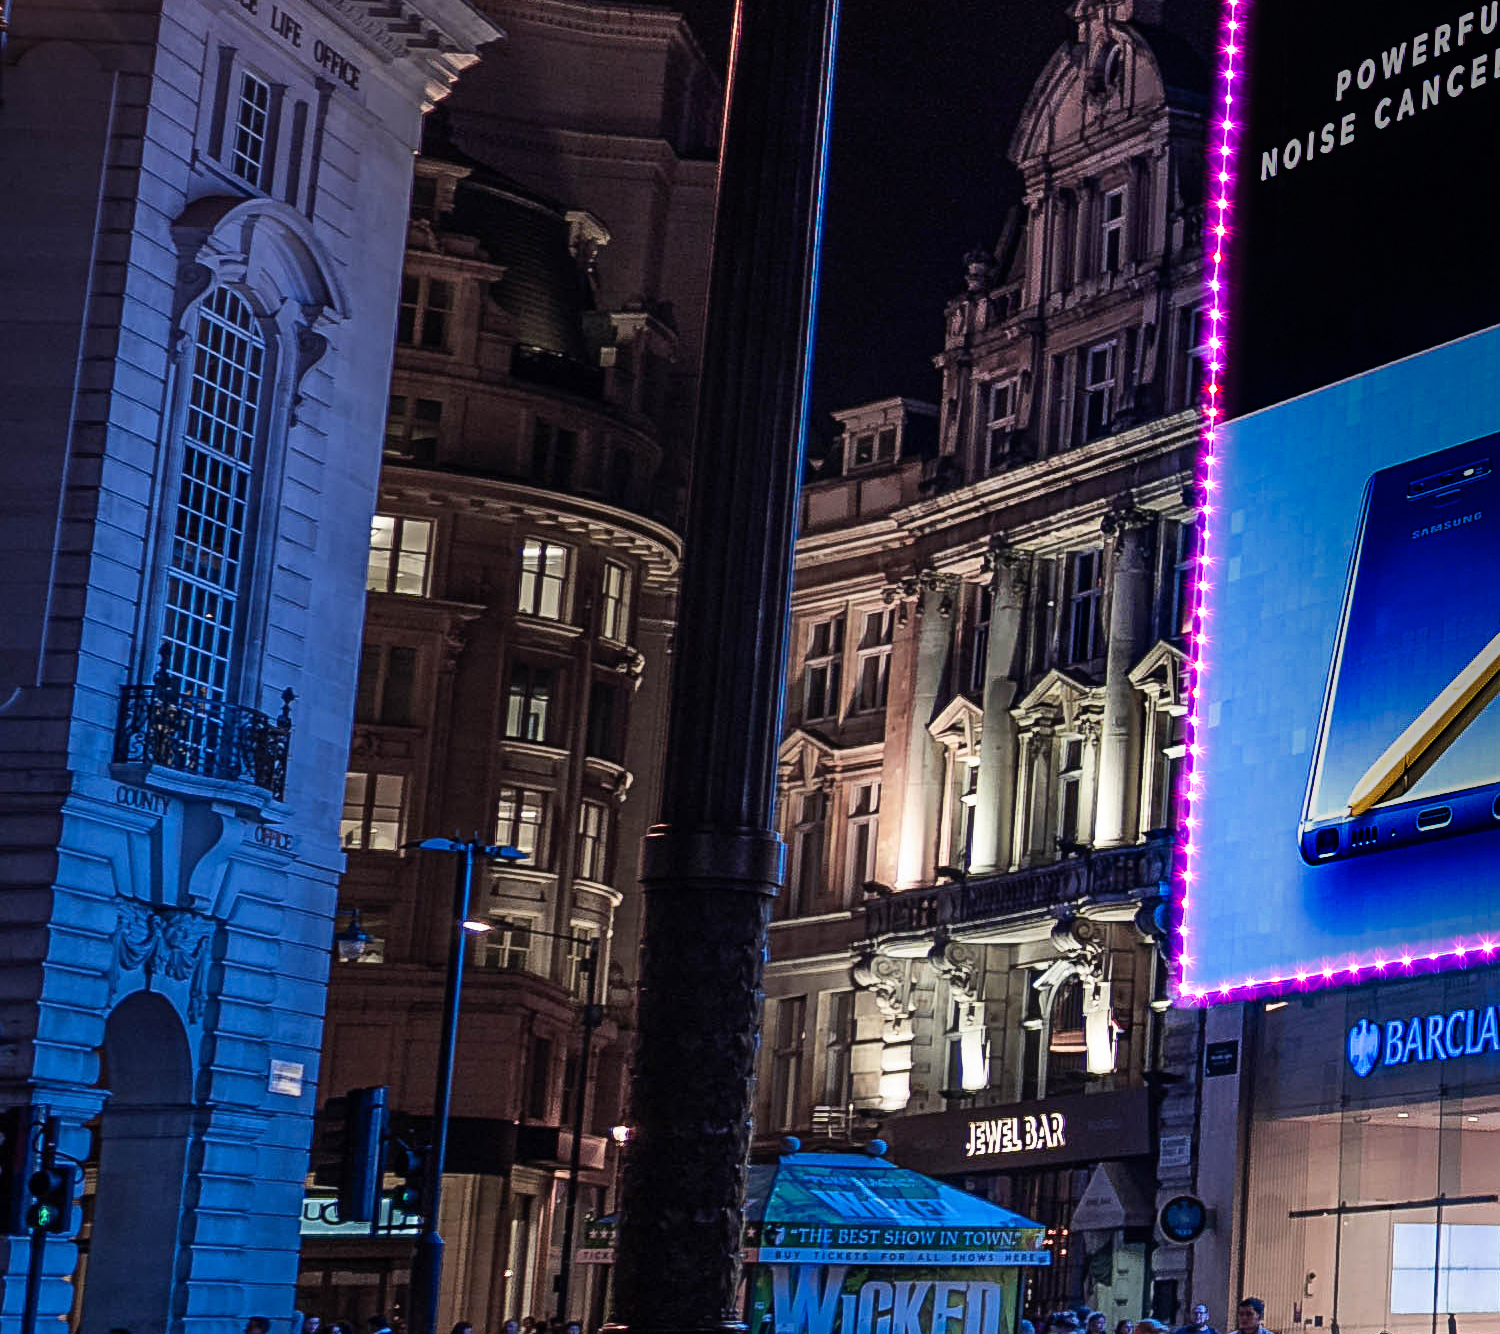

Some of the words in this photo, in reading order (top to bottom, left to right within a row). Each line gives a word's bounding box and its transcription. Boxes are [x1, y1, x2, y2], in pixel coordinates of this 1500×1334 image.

[270, 4, 303, 48] LIFE
[313, 39, 361, 91] OFFICE
[1260, 112, 1356, 181] NOISE
[1411, 510, 1483, 540] SAMSUNG
[965, 1119, 1022, 1157] JEWEL
[1024, 1113, 1066, 1151] BAR
[838, 1228, 880, 1246] BEST
[884, 1229, 935, 1246] SHOW
[940, 1231, 958, 1246] IN
[775, 1250, 801, 1260] BUY
[814, 1251, 869, 1261] TICKETS
[880, 1252, 905, 1261] FOR
[917, 1252, 939, 1261] ALL
[951, 1253, 997, 1262] SHOWS
[1004, 1253, 1035, 1263] HERE
